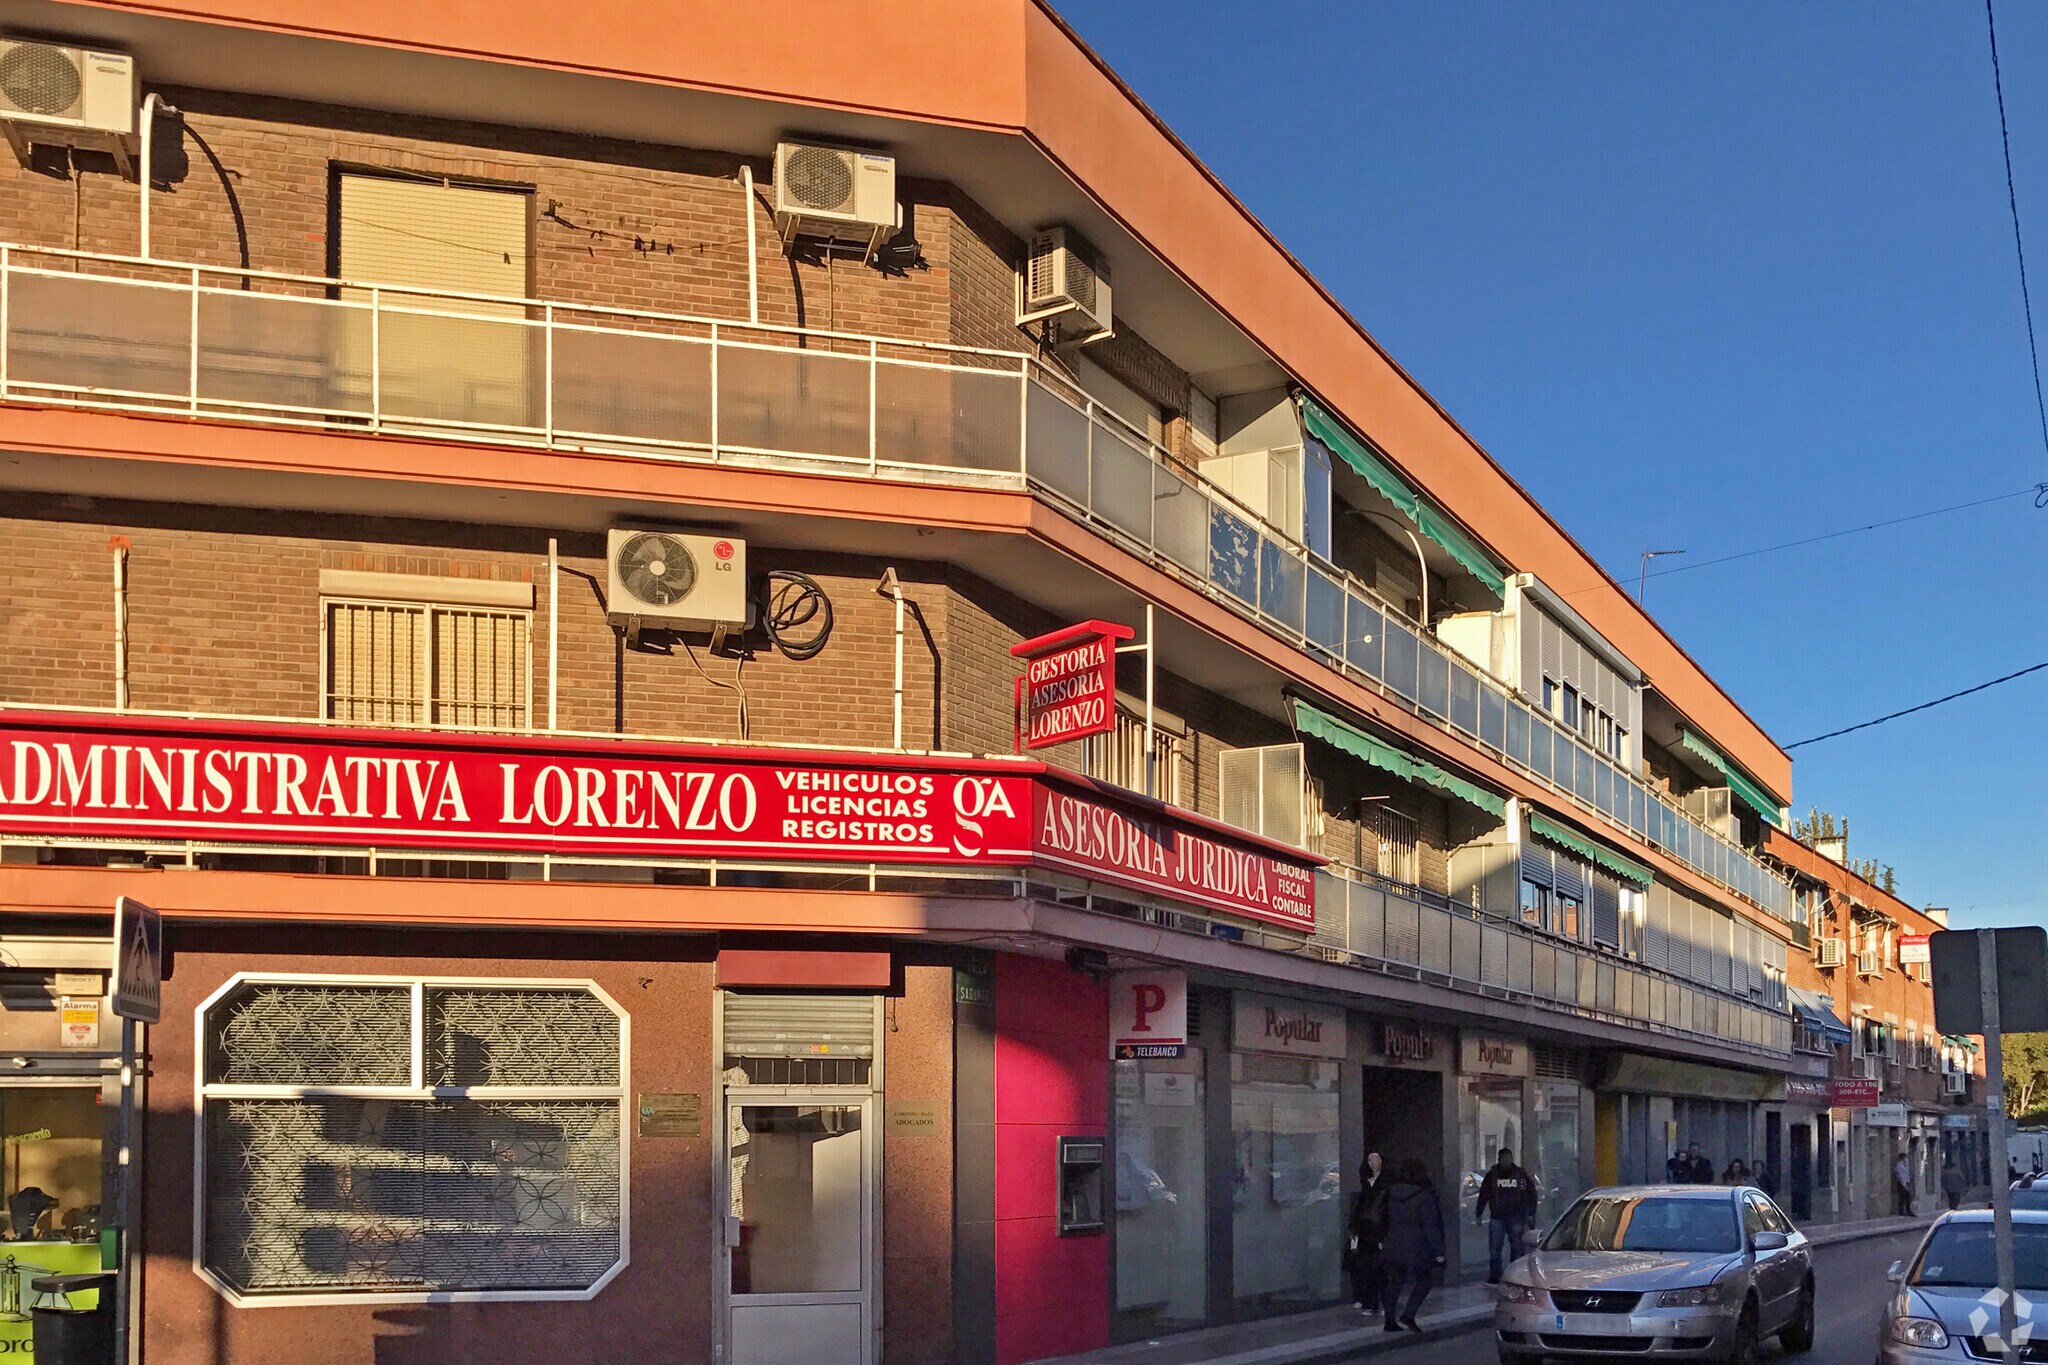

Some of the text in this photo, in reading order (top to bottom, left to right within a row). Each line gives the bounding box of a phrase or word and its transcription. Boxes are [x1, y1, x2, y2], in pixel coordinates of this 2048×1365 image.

[715, 561, 732, 571] LG
[1030, 643, 1106, 683] GESTORIA
[1032, 670, 1105, 709] ASESORIA
[1030, 698, 1105, 740] LORENZO
[0, 741, 757, 833] DMINISTRATIVA LORENZO
[775, 771, 934, 796] VEHICULOS
[788, 795, 928, 818] LICENCIAS
[782, 819, 934, 843] REGISTROS
[1041, 791, 1269, 905] ASESORIA JURIDICA
[1271, 861, 1311, 884] LABORAL
[1278, 878, 1307, 900] FISCAL
[1272, 895, 1312, 919] CONTABLE
[1131, 984, 1166, 1031] P
[1264, 1007, 1323, 1046] Popular
[1137, 1046, 1177, 1057] TELEBANCO
[1478, 1040, 1513, 1068] Popular
[1497, 1179, 1517, 1188] POLO
